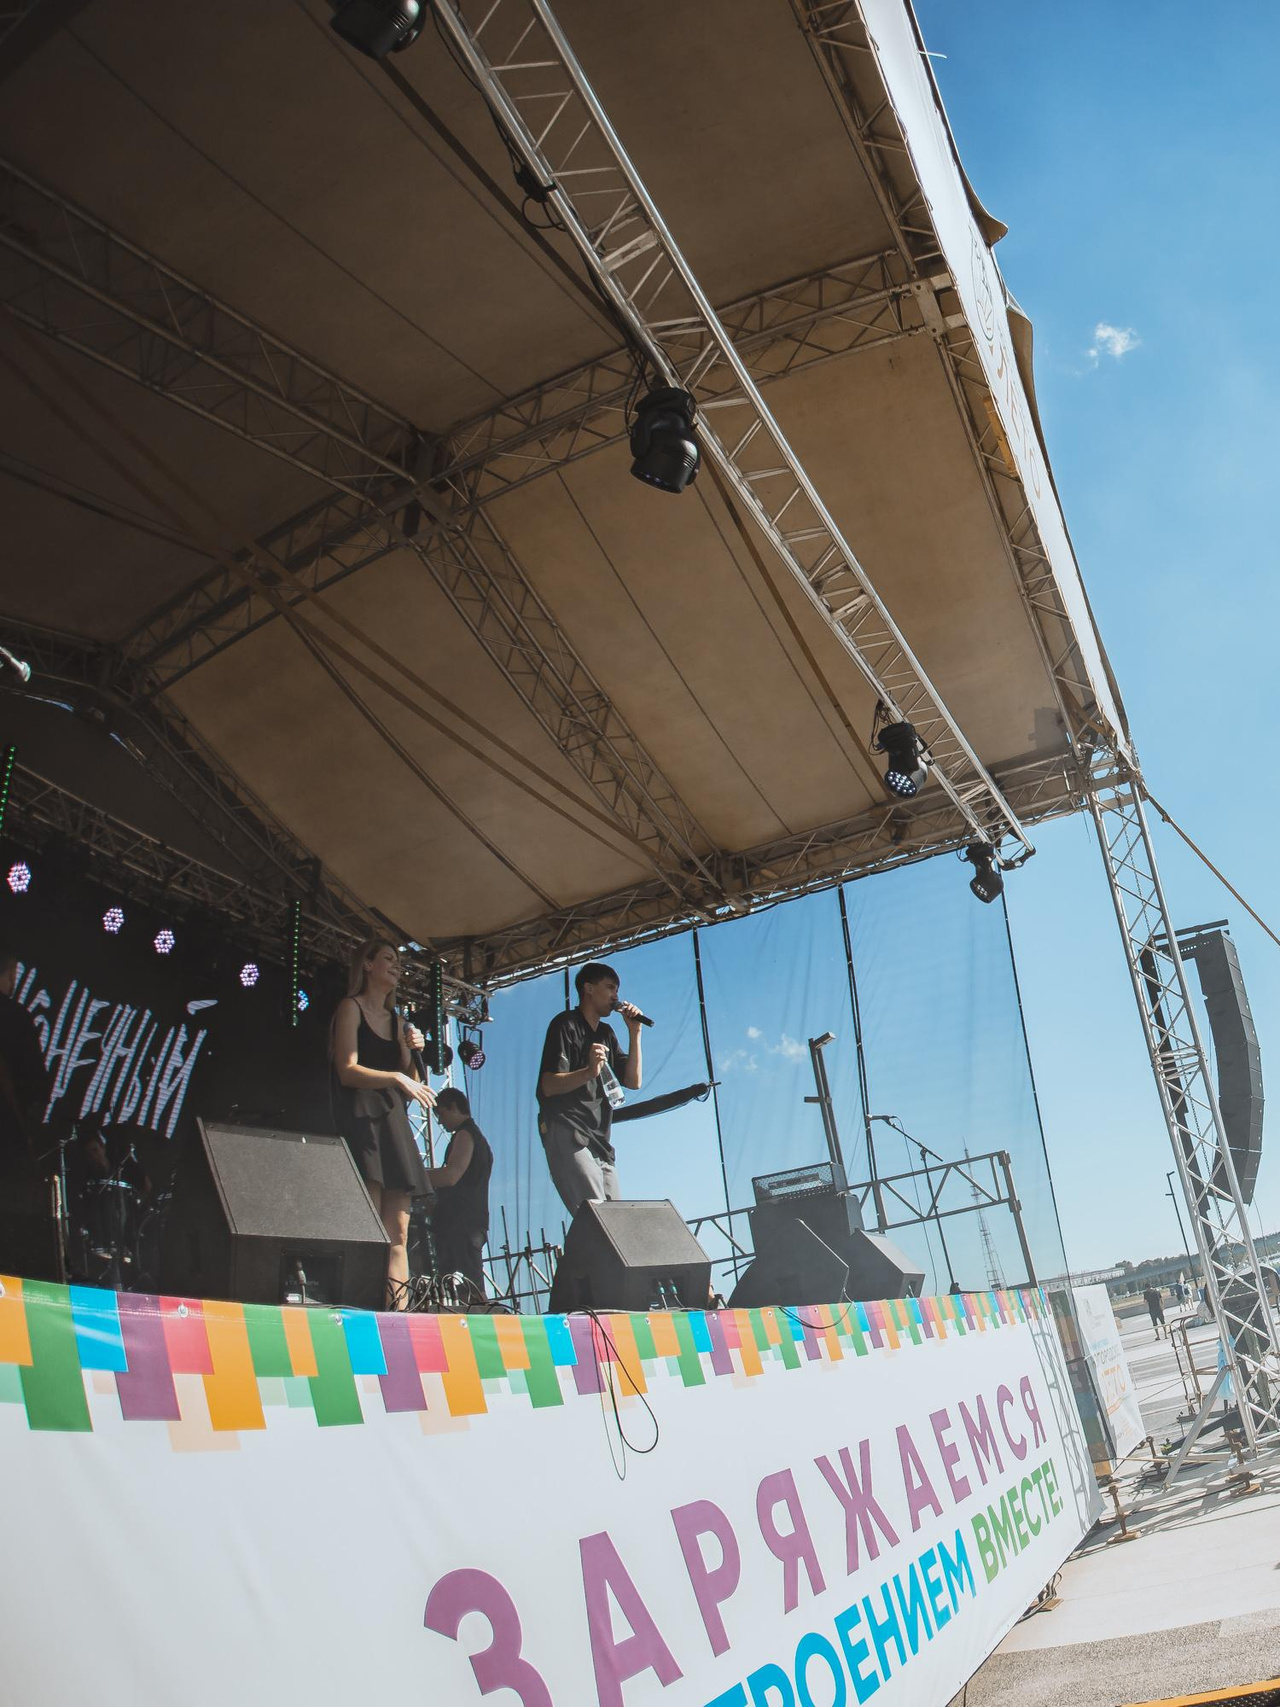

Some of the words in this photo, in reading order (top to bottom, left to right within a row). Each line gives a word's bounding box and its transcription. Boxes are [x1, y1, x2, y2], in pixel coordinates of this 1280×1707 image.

[424, 1375, 1047, 1707] ЗАРЯЖАЕМСЯ
[702, 1529, 977, 1707] ОЕНИЕМ
[970, 1457, 1064, 1584] ВМЕСТЕ!
